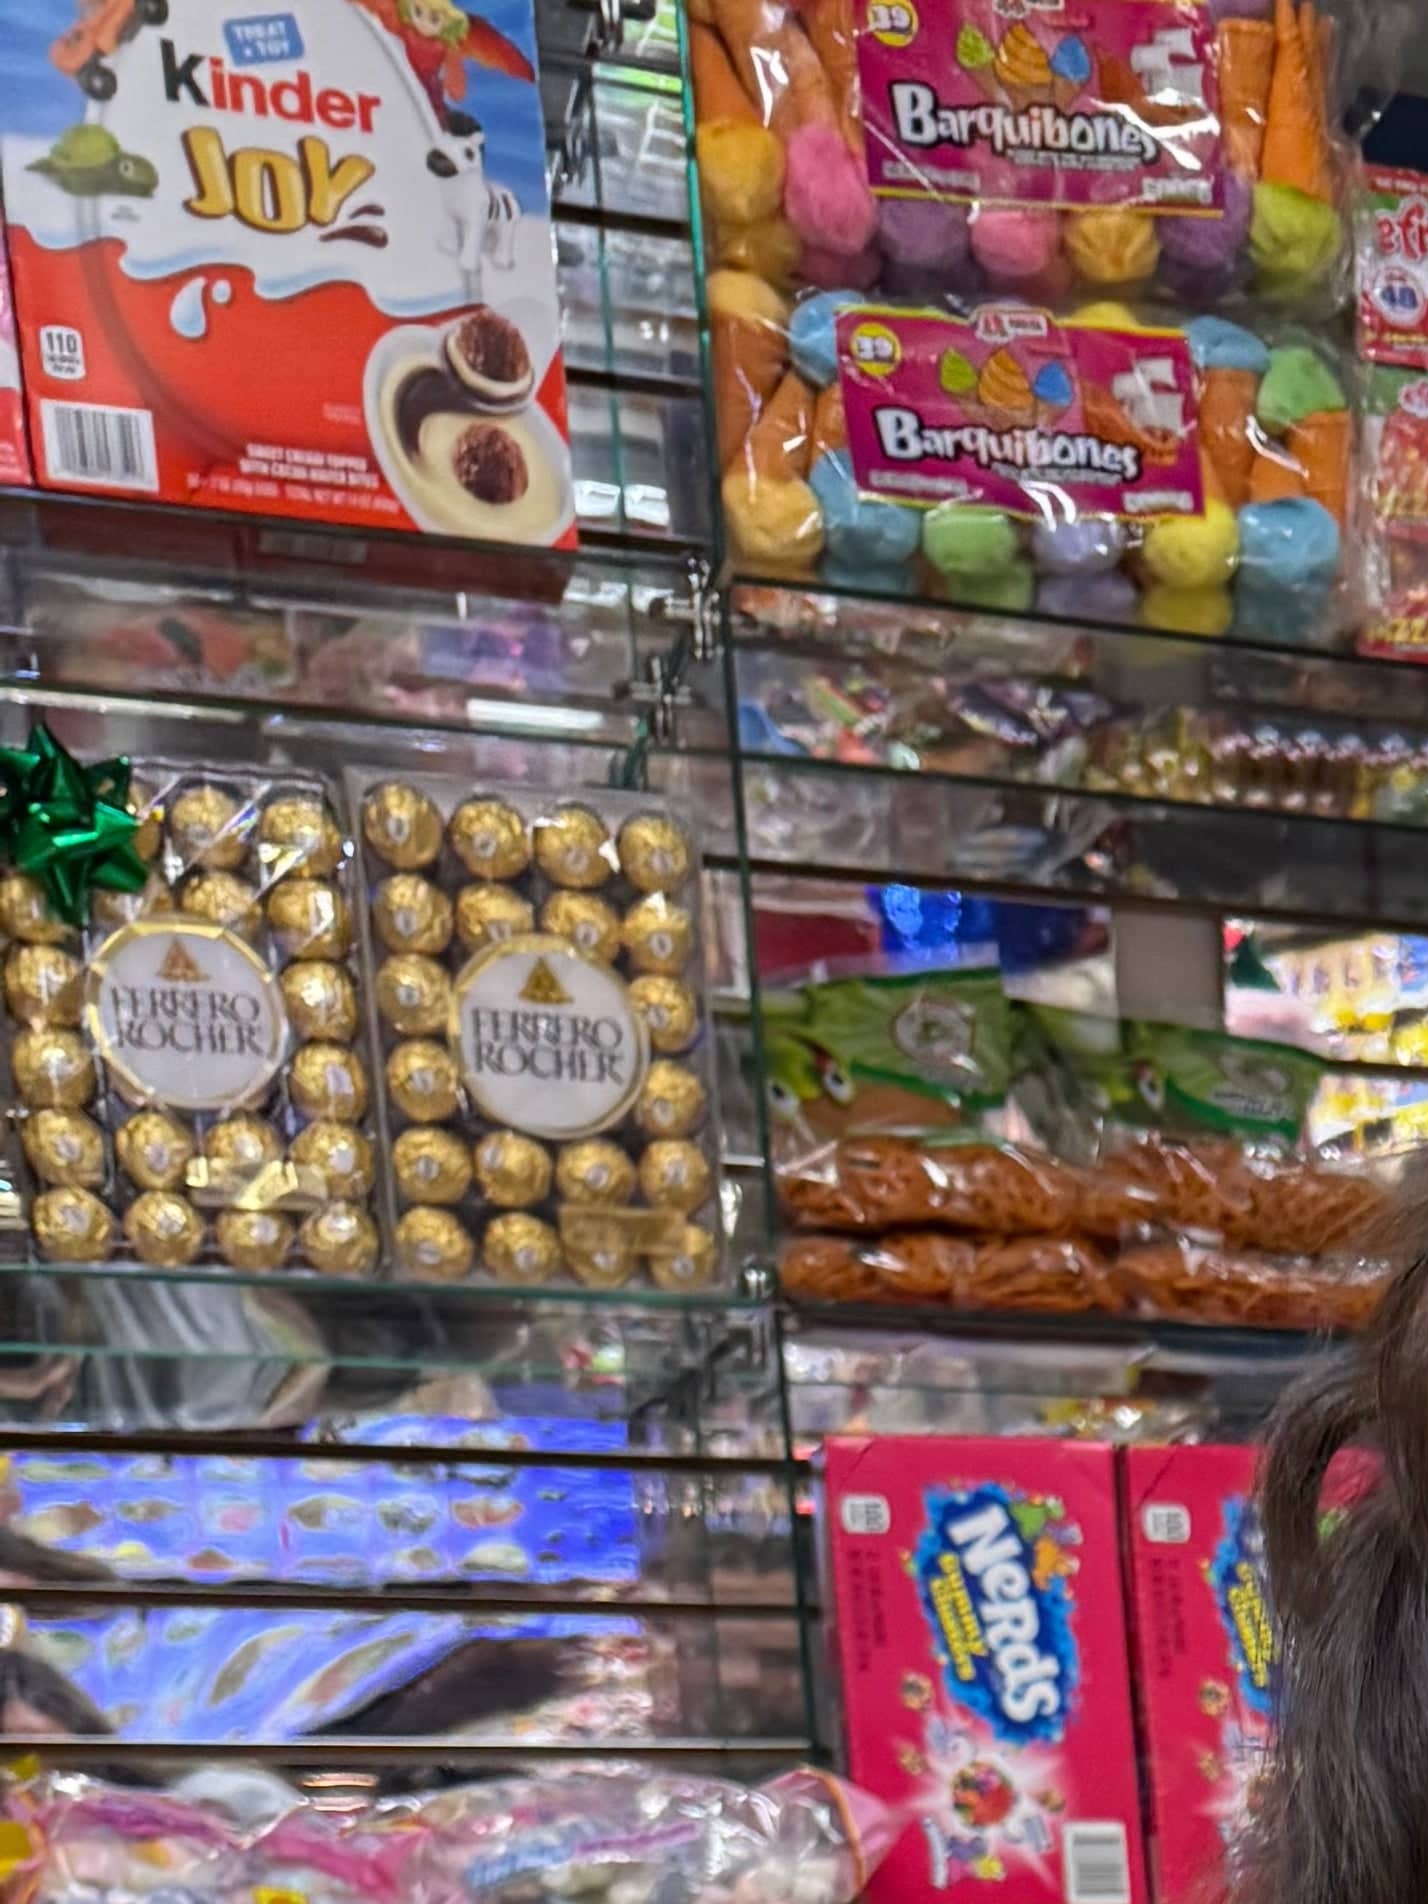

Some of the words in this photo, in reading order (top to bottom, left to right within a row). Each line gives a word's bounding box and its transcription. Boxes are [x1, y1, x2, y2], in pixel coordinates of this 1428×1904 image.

[889, 81, 1158, 163] Barquibones
[179, 124, 377, 235] JOY
[873, 406, 1140, 478] Barquibones
[112, 986, 262, 1026] FERRERO
[471, 1007, 624, 1051] FERRERO
[118, 1016, 264, 1057] ROCHER
[475, 1042, 626, 1085] ROCHER
[938, 1552, 987, 1658] GUMMY
